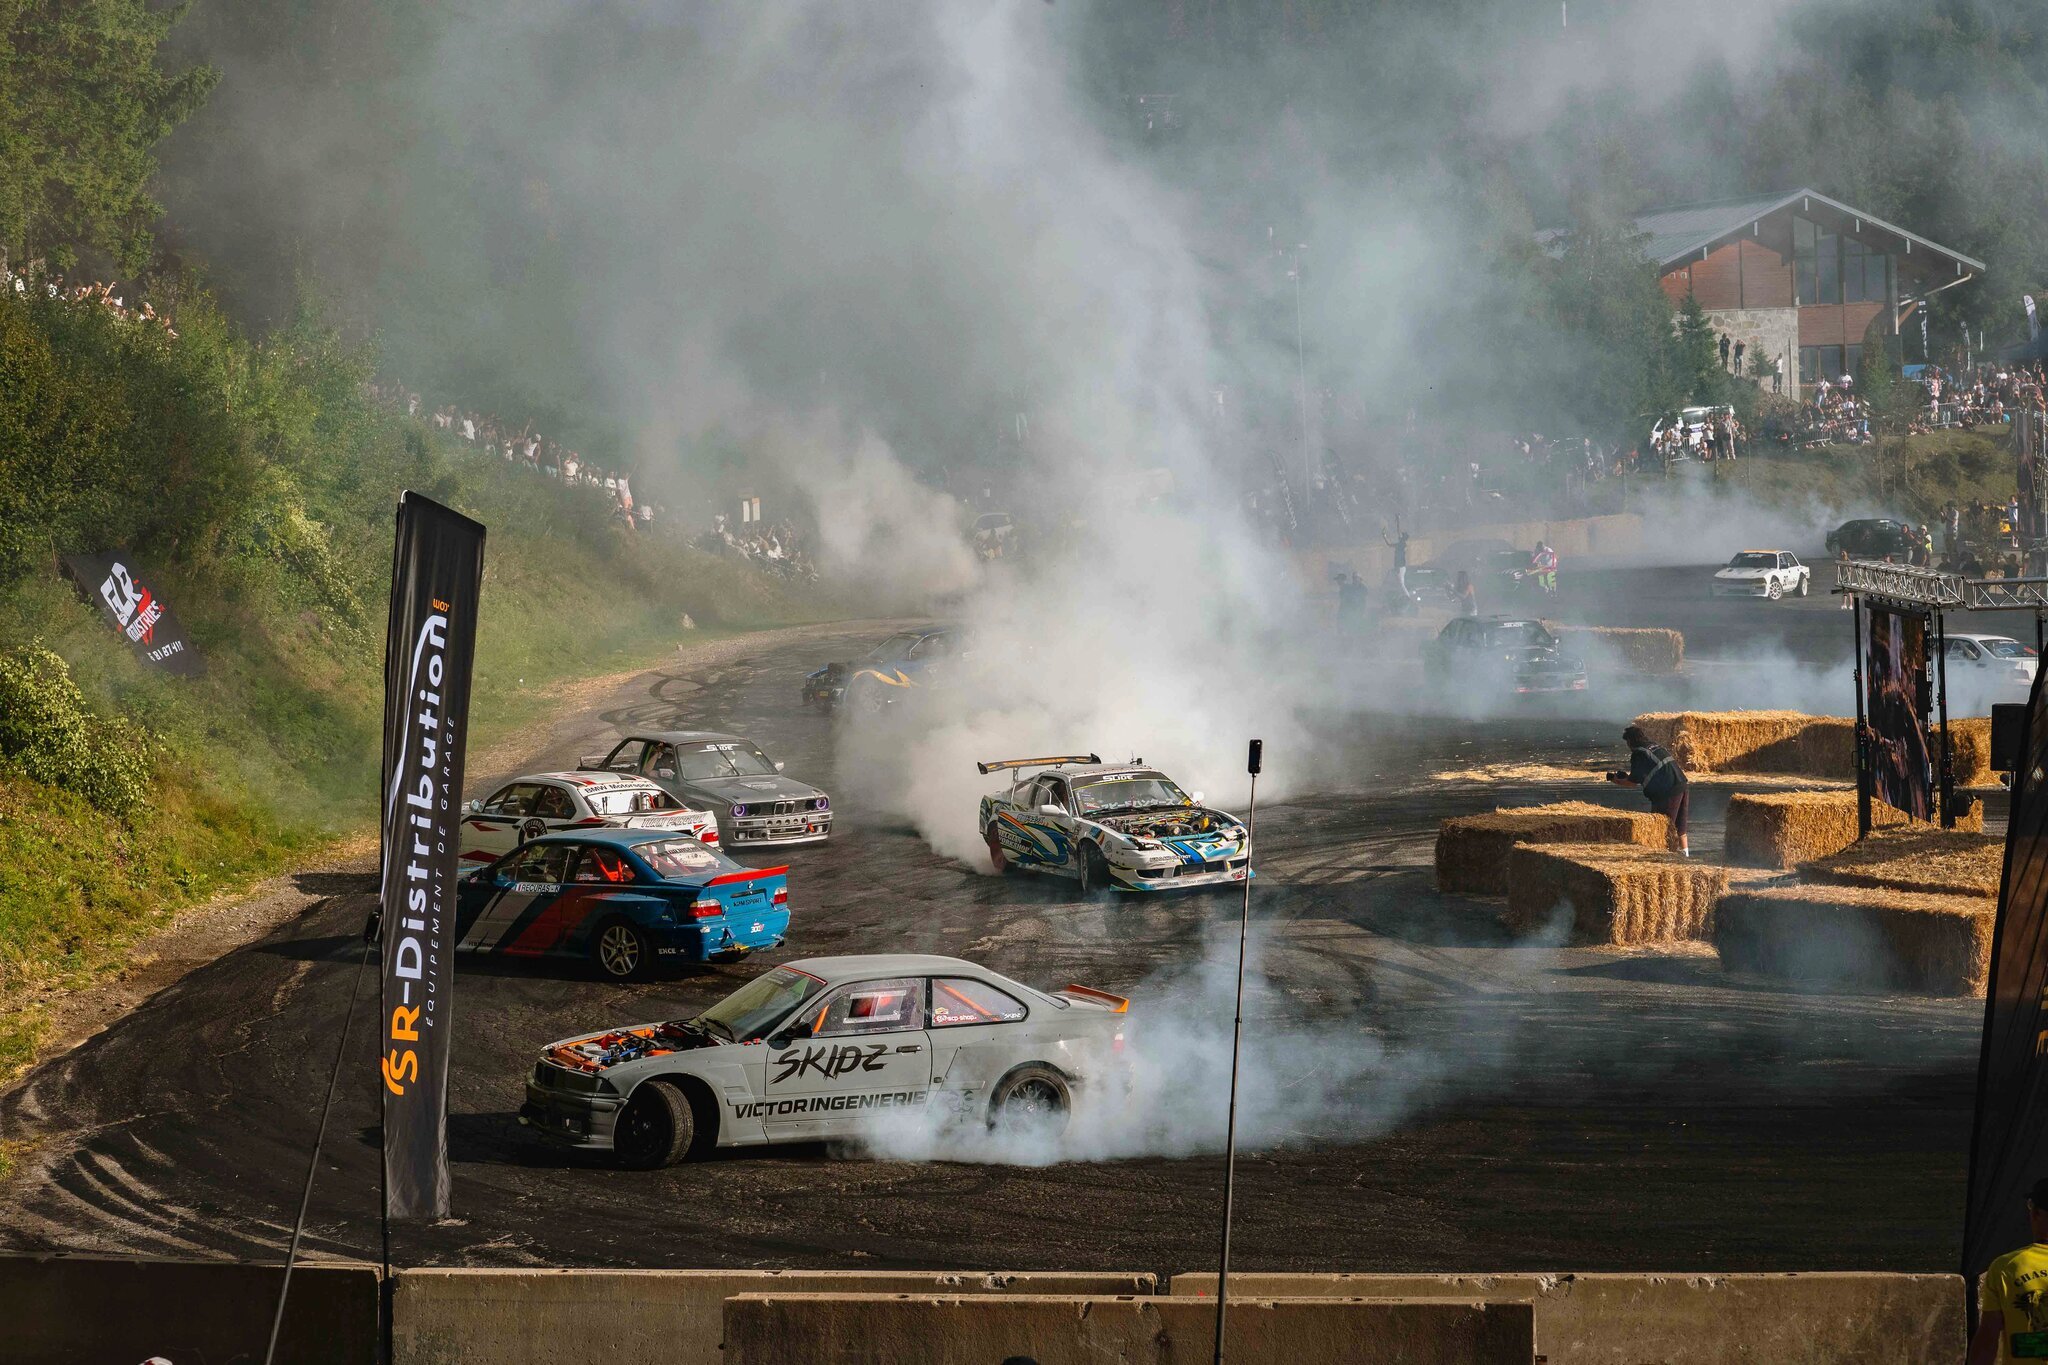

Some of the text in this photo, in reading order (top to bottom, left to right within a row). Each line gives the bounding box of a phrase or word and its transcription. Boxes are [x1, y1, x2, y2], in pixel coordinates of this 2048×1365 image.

[382, 614, 448, 1096] SR-Distribution
[425, 716, 456, 1027] ÉQUIPEMENT DE GARAGE
[584, 785, 608, 794] BMW
[735, 1090, 928, 1119] VICTOR INGENIERIE
